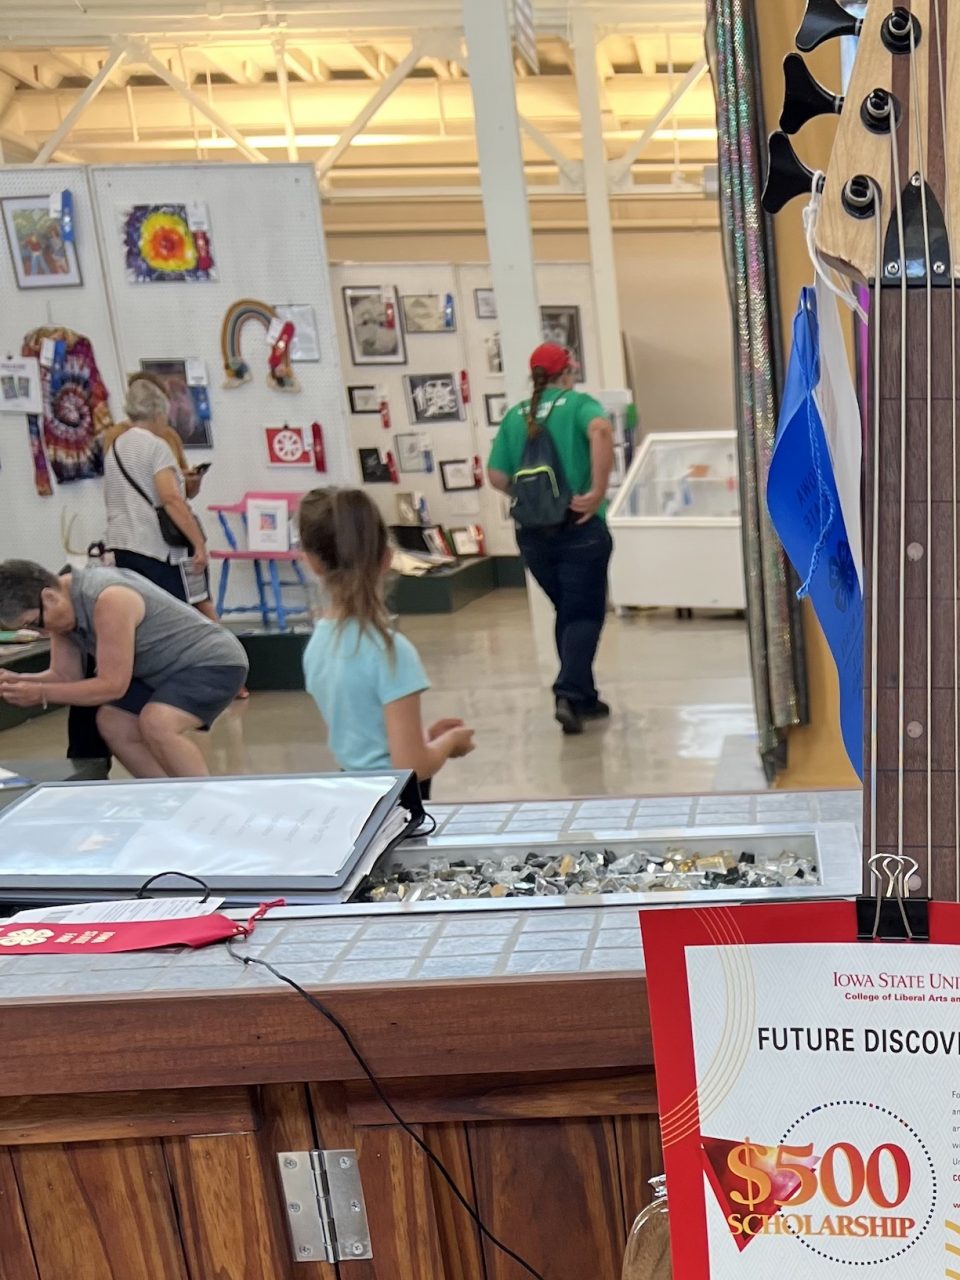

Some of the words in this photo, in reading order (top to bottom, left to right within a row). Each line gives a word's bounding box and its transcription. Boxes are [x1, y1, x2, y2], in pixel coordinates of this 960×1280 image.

[833, 972, 875, 988] IOWA
[878, 972, 925, 989] STATE
[845, 992, 880, 1002] College
[882, 993, 892, 1001] of
[894, 993, 925, 1002] Liberal
[929, 994, 948, 1003] Arts
[758, 1027, 855, 1052] FUTURE
[727, 1136, 911, 1210] $500
[727, 1213, 916, 1239] SCHOLARSHIP
